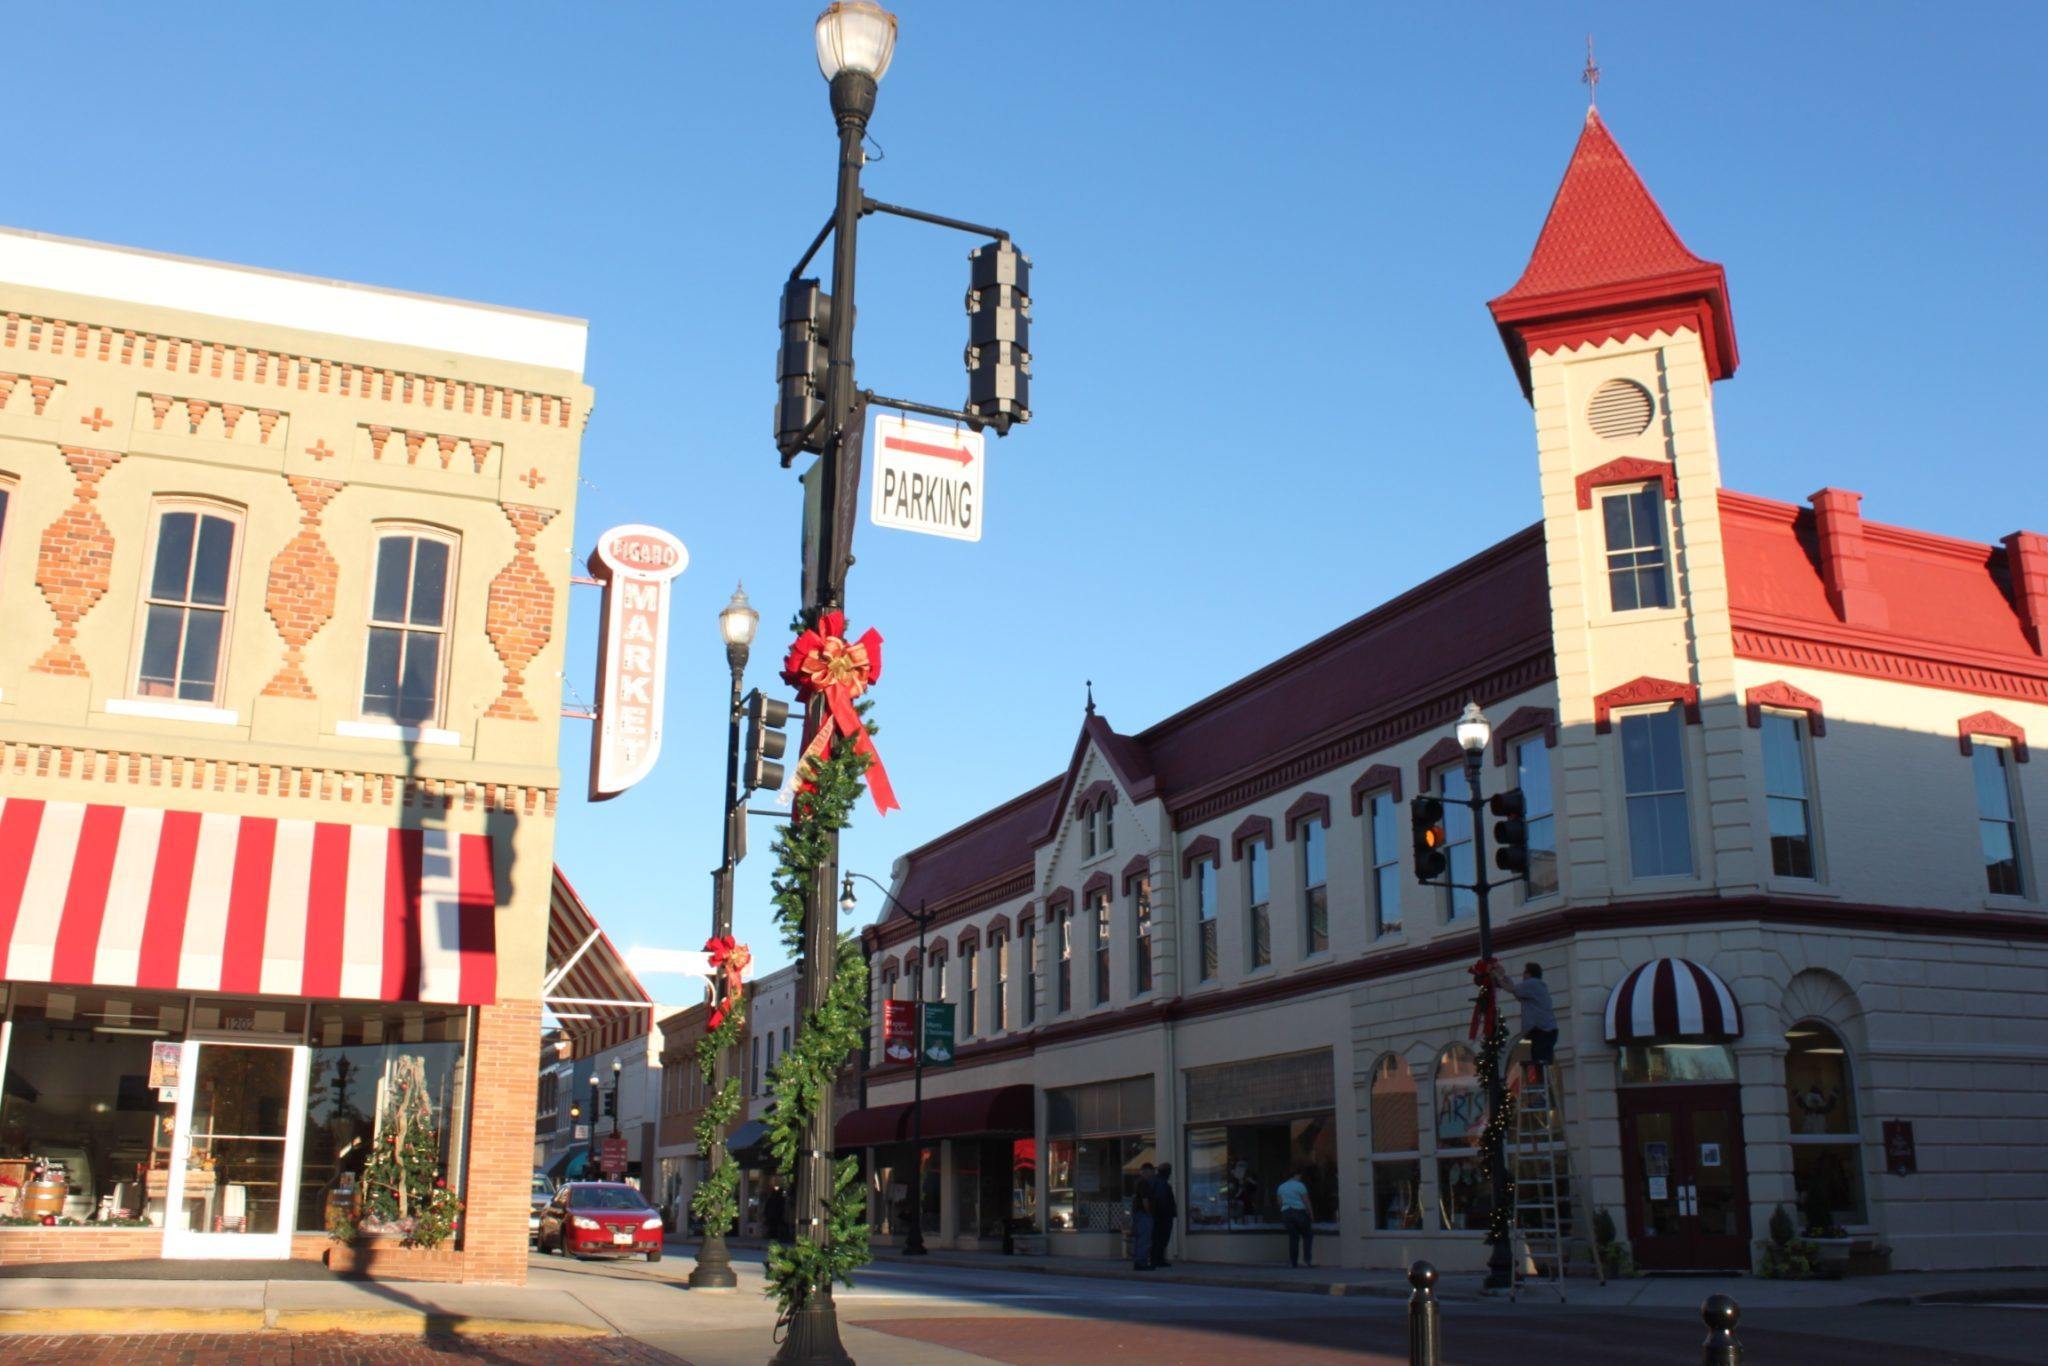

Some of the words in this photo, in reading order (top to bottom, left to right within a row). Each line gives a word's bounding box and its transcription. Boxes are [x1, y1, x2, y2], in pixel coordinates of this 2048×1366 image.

[883, 467, 972, 529] PARKING
[613, 538, 675, 566] FIGARO
[621, 583, 658, 768] MARKET
[1439, 1091, 1485, 1124] ARTS
